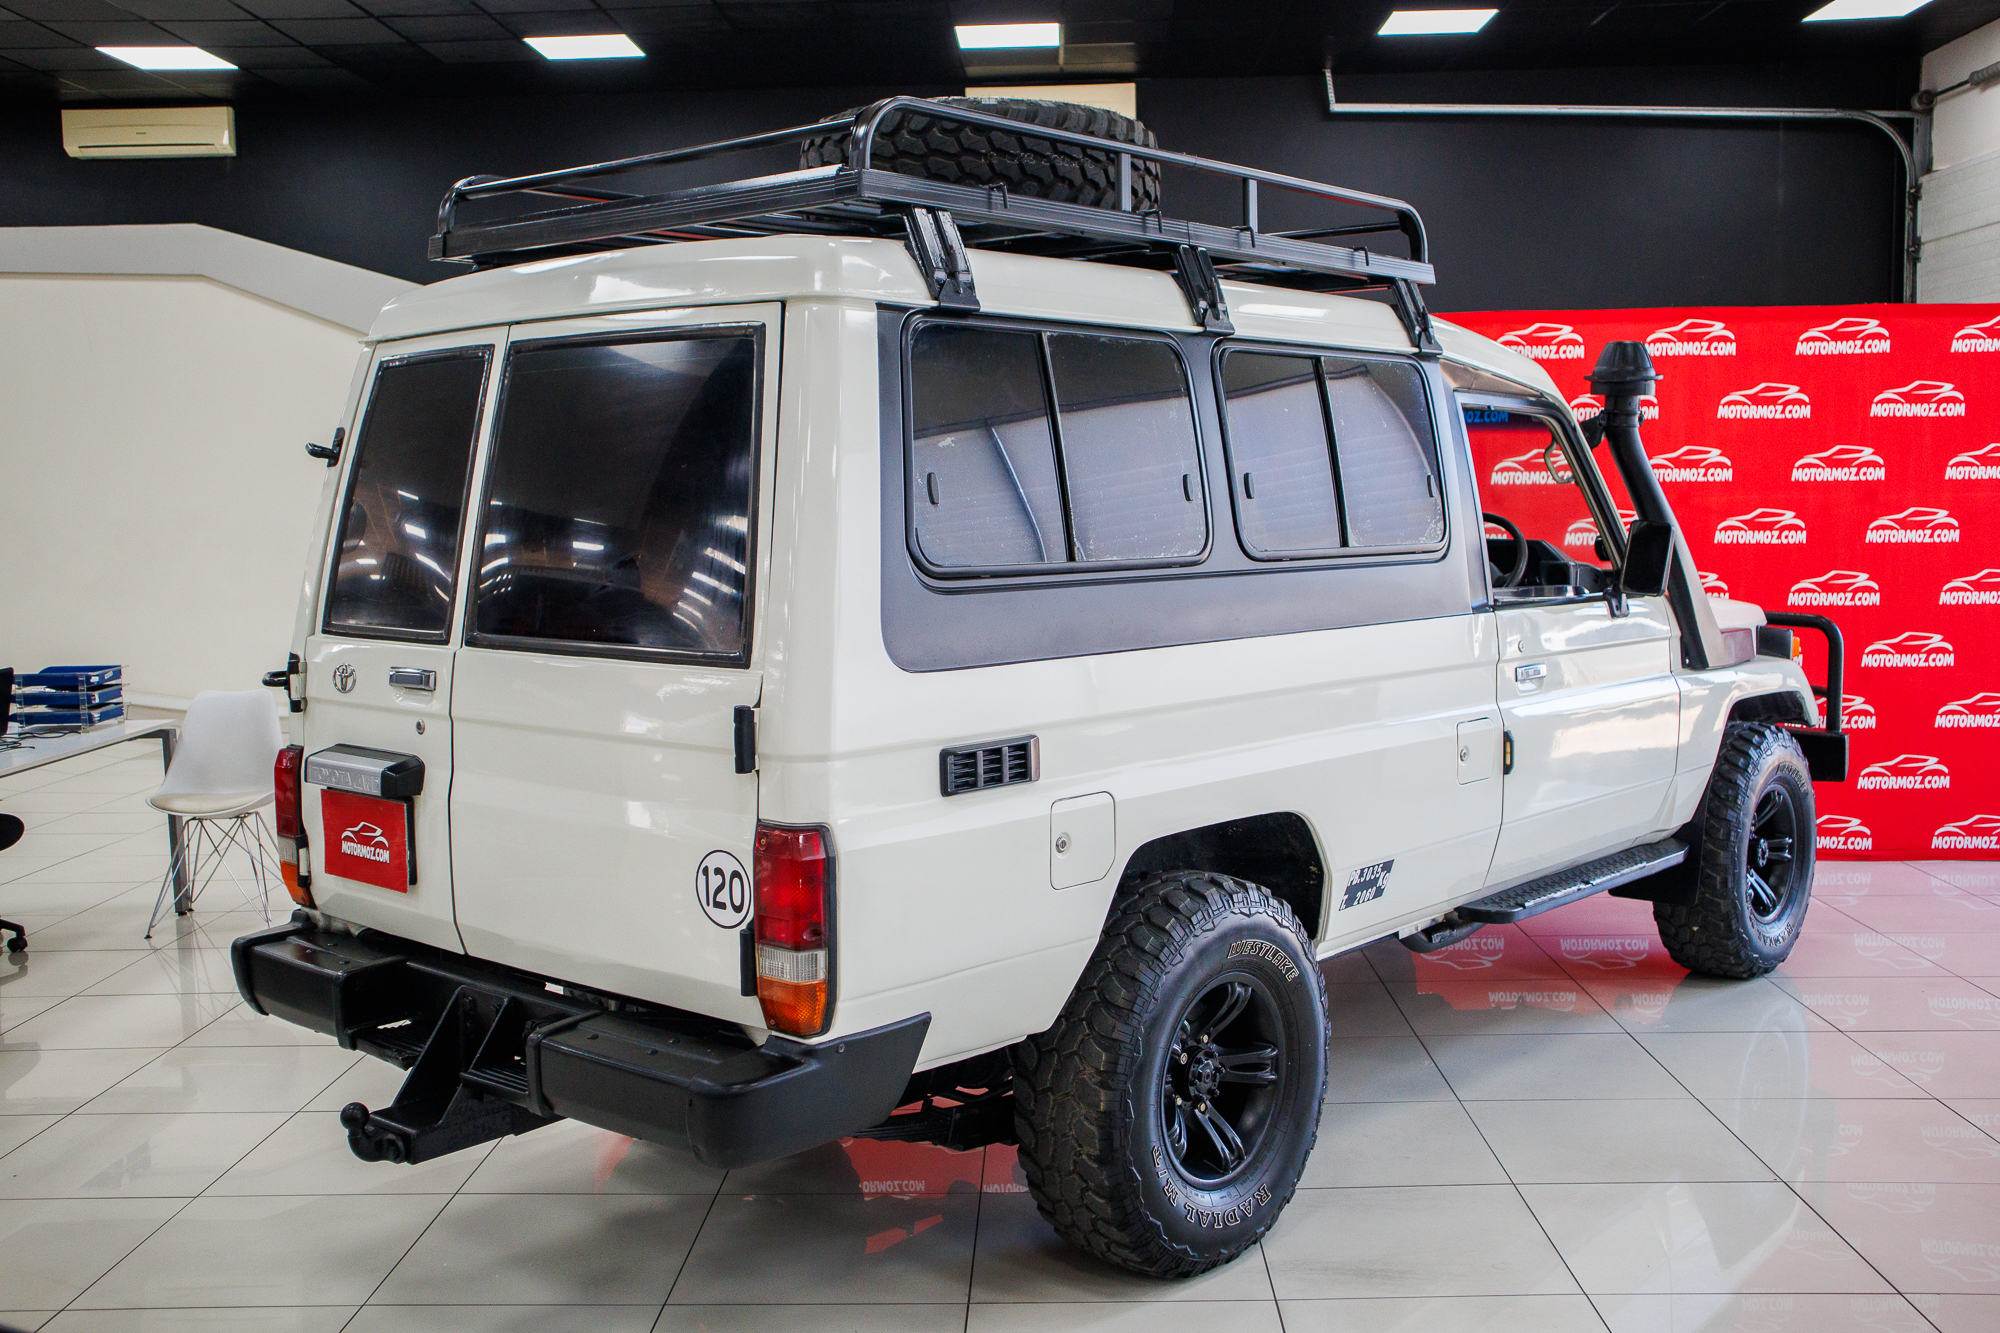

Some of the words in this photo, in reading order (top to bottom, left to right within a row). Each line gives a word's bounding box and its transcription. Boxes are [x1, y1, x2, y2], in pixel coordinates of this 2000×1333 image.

[1645, 341, 1737, 357] MOTORMOZ.COM
[1795, 339, 1891, 356] MOTORMOZ.COM
[1716, 404, 1811, 420] MOTORMOZ.COM
[1869, 402, 1966, 418] MOTORMOZ.COM
[1790, 467, 1886, 482] MOTORMOZ.COM
[1713, 529, 1807, 545] MOTORMOZ.COM
[1865, 528, 1960, 544] MOTORMOZ.COM
[1787, 592, 1881, 607] MOTORMOZ.COM
[1860, 653, 1955, 668] MOTORMOZ.COM
[309, 766, 352, 788] TOYOTA
[1857, 775, 1950, 790] MOTORMOZ.COM
[341, 840, 390, 864] MOTORMOZ.COM
[701, 864, 745, 915] 120
[1352, 886, 1377, 906] 2060
[1226, 938, 1300, 983] WESTLAKE
[1184, 1183, 1272, 1229] RADIAL
